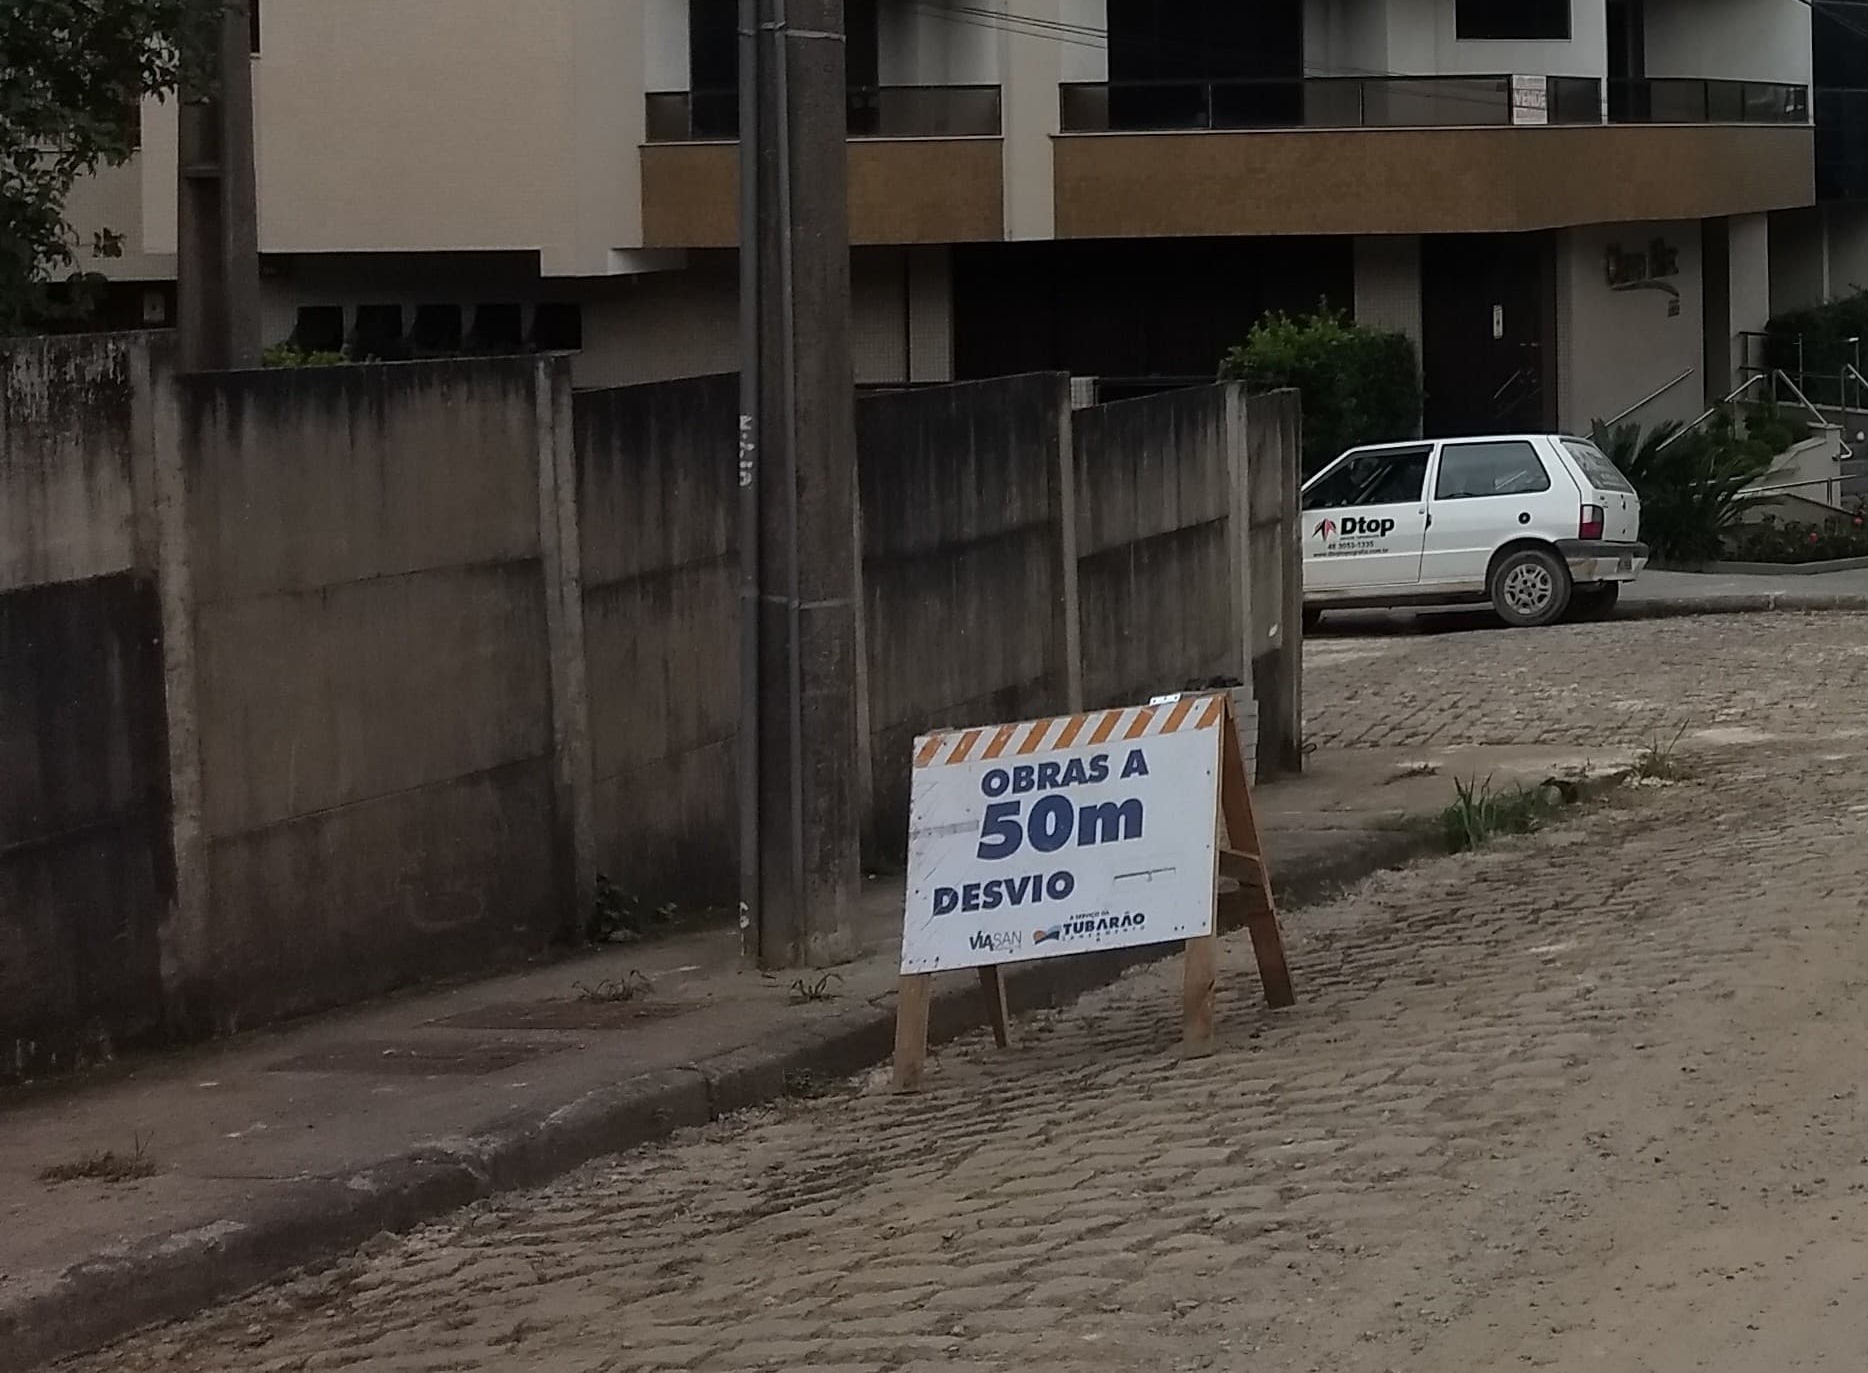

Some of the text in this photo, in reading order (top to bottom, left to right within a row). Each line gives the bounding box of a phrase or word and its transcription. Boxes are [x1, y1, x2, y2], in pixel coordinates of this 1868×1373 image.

[1340, 516, 1395, 538] Dtop
[981, 748, 1149, 798] OBRAS A
[976, 794, 1144, 861] 50m
[932, 870, 1076, 916] DESVIO
[1061, 911, 1146, 936] TUBARÃO
